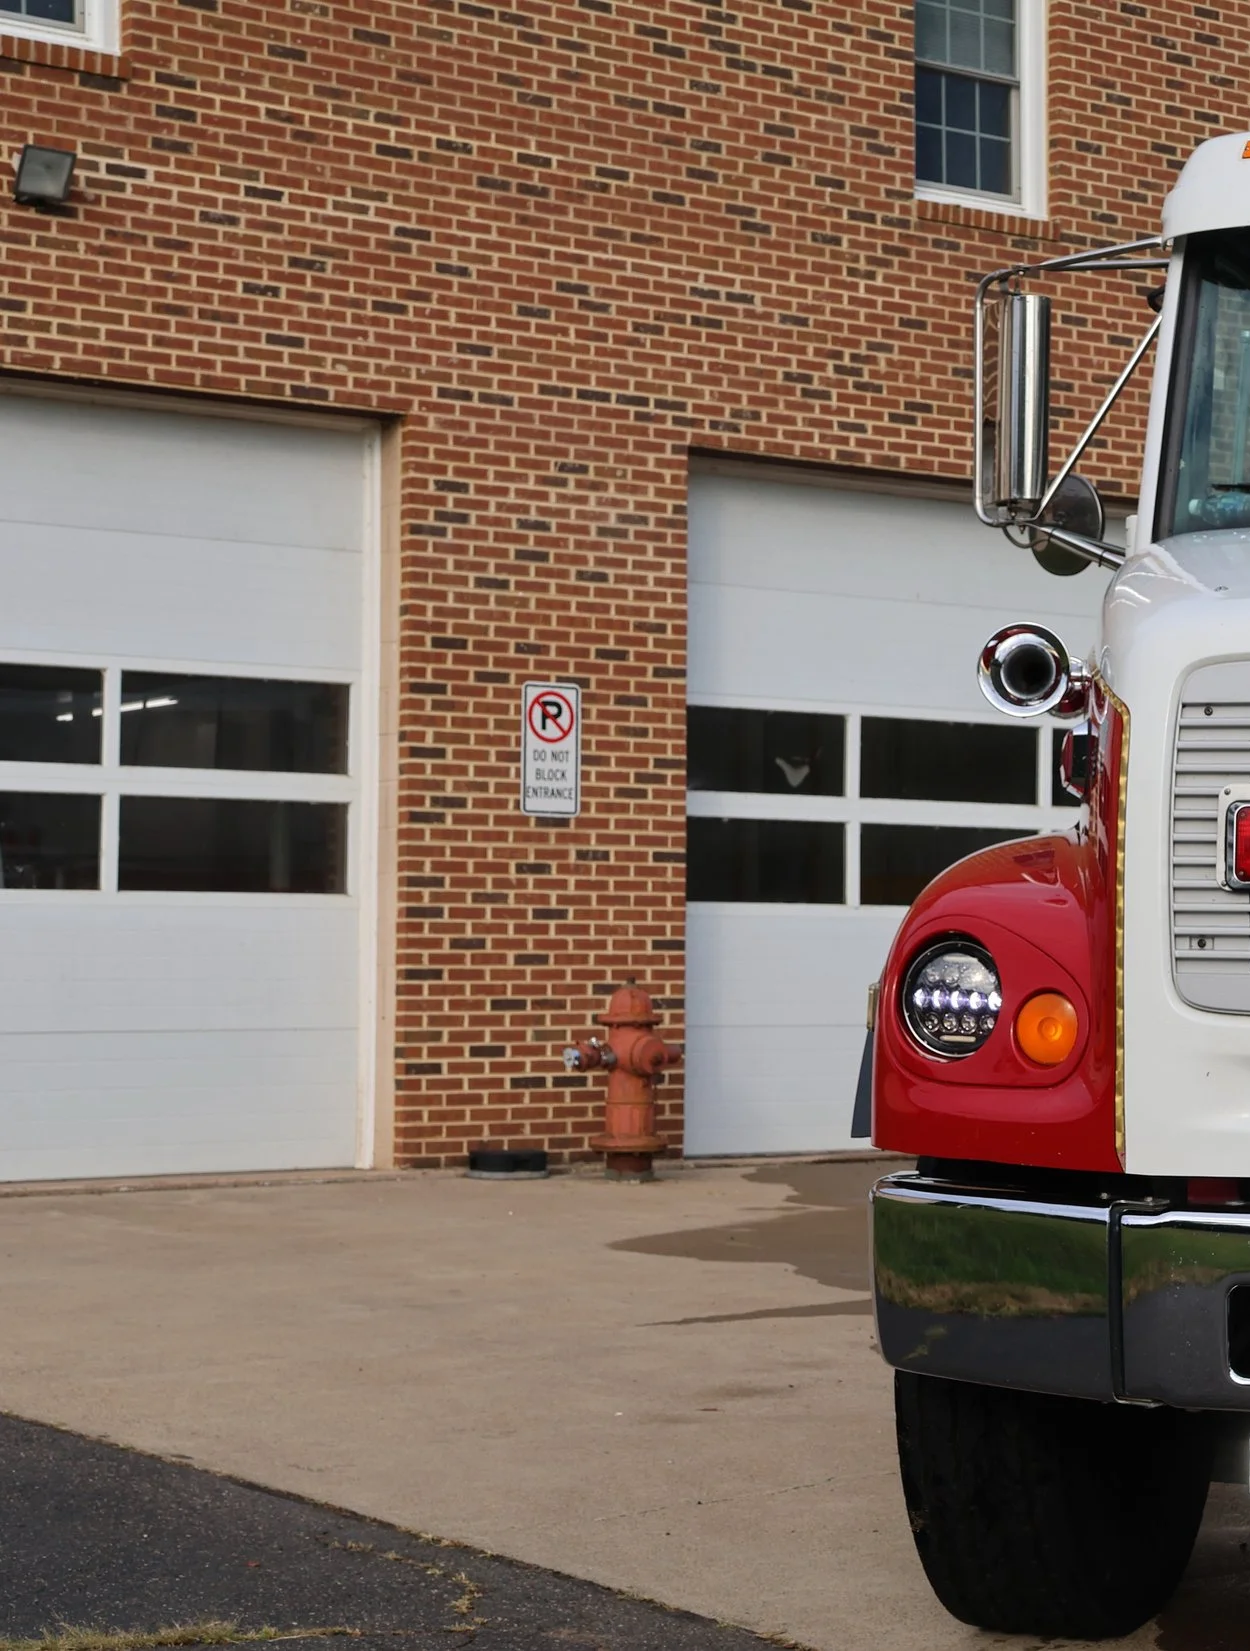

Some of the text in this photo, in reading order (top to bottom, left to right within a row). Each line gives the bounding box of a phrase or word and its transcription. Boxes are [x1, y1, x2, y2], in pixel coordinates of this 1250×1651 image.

[533, 749, 569, 763] DO NOT
[535, 768, 568, 782] BLOCK
[525, 785, 573, 800] ENTRANCE
